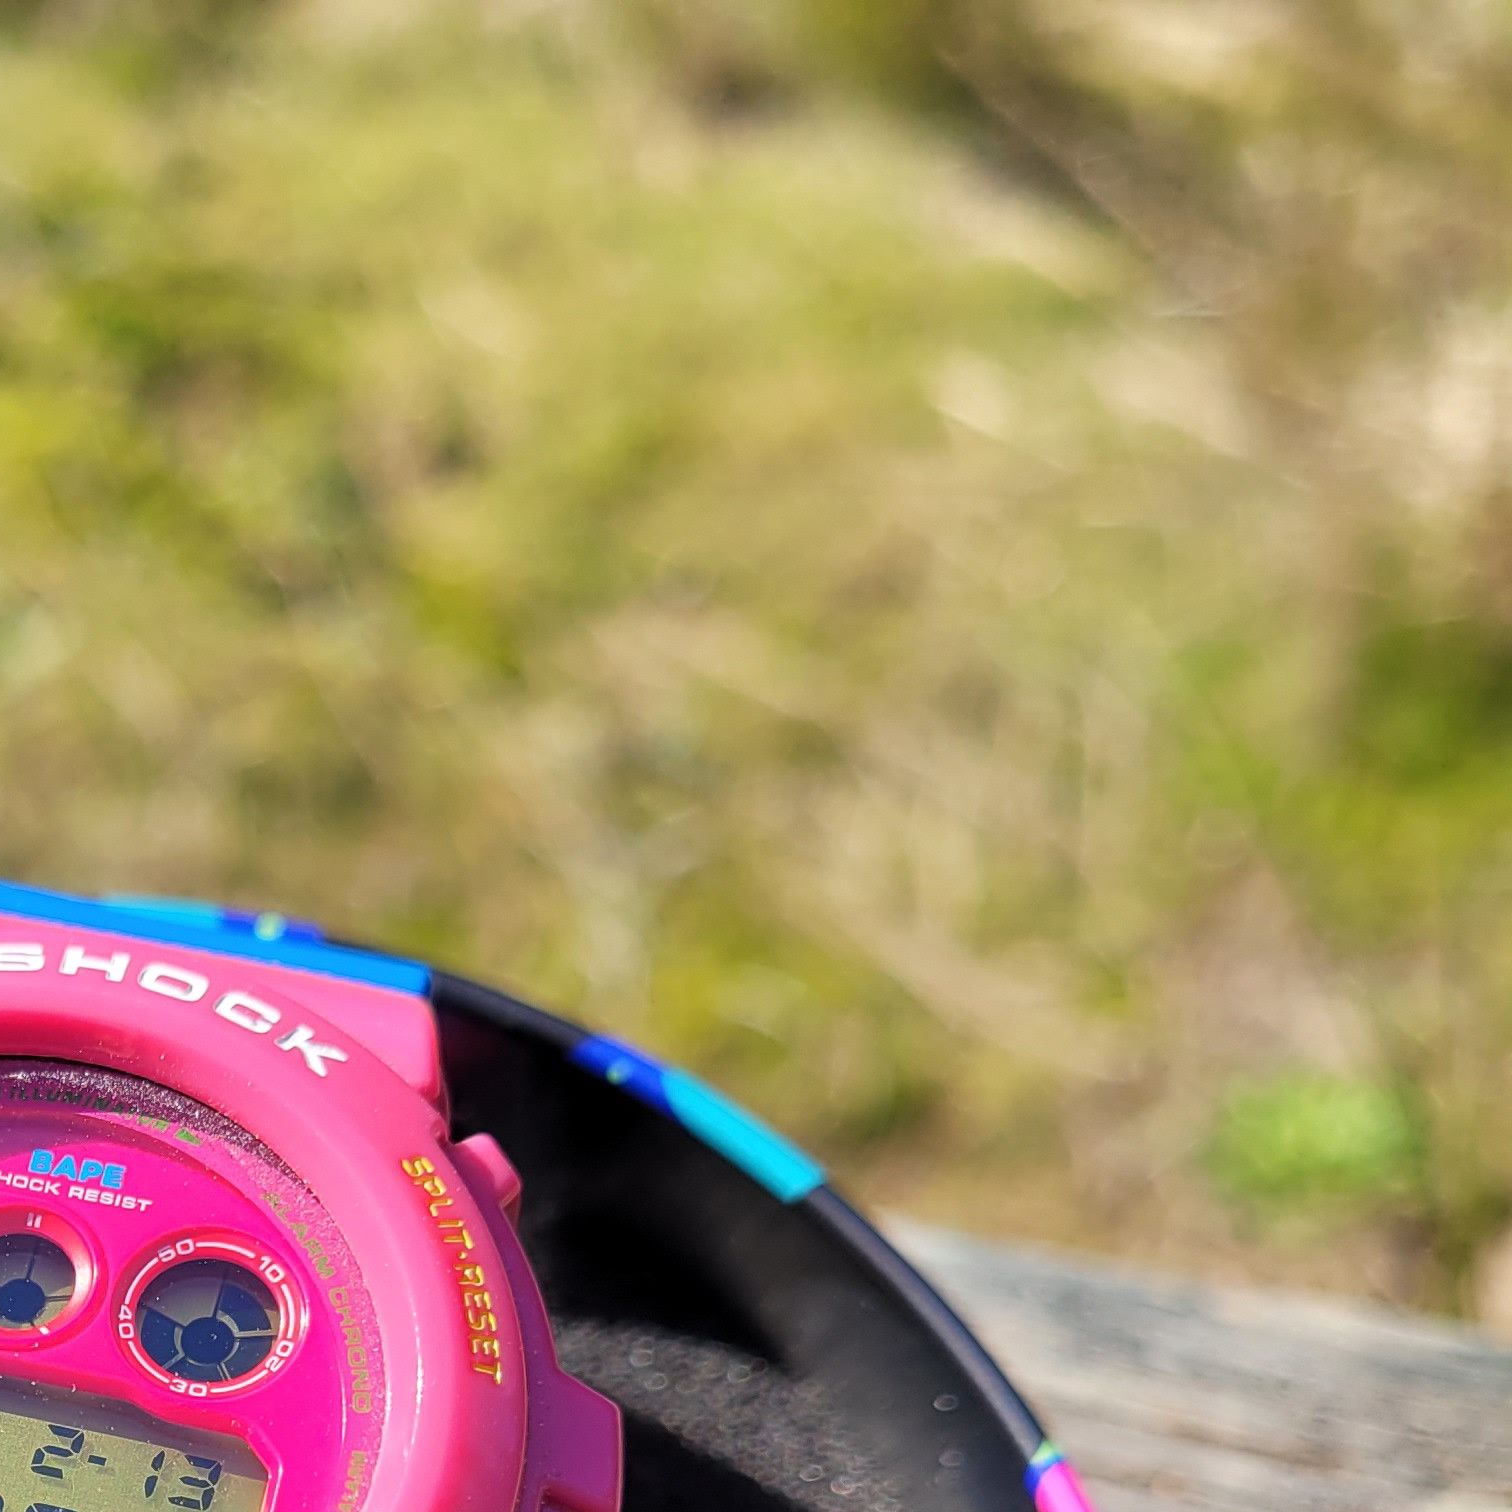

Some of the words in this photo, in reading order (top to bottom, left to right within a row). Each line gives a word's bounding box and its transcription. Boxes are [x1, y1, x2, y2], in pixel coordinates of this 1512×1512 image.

[28, 1149, 127, 1189] BAPE
[67, 1184, 154, 1213] RESIST
[157, 1238, 196, 1264] 50
[257, 1255, 287, 1284] 10
[262, 1190, 336, 1281] ALARM
[327, 1286, 373, 1414] CHRONO
[118, 1304, 135, 1340] 40
[264, 1339, 295, 1374] 20
[169, 1377, 208, 1397] 30
